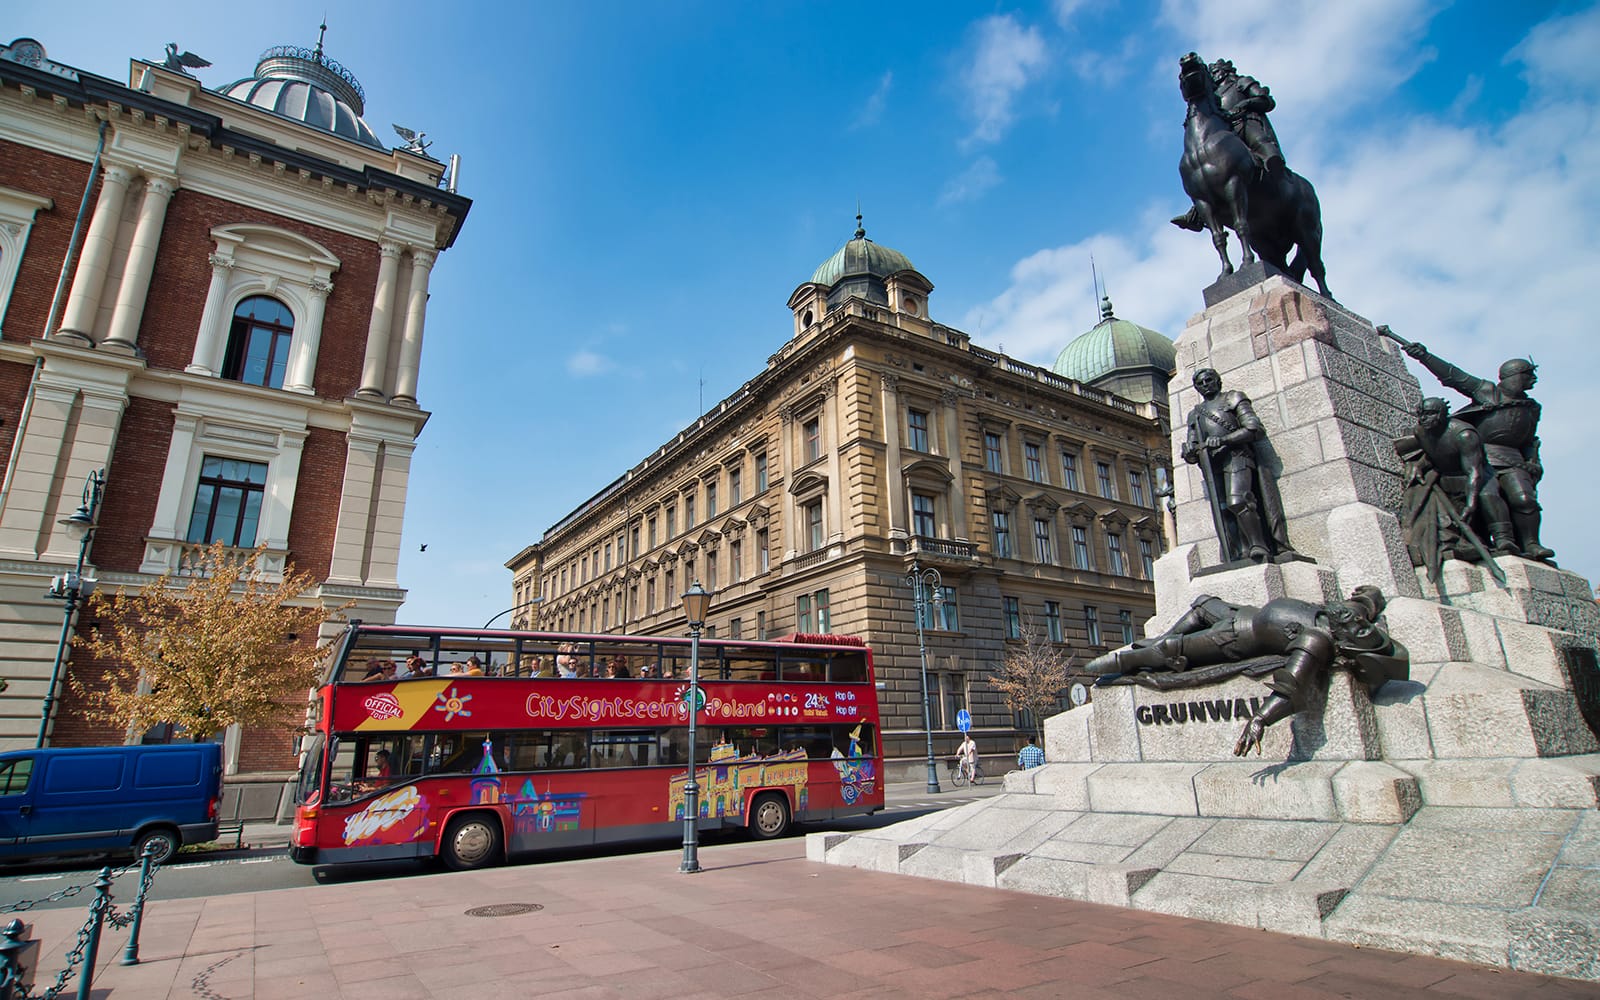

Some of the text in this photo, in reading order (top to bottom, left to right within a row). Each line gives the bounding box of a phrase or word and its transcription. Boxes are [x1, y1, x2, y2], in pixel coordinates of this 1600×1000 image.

[834, 690, 856, 701] Hop On
[364, 698, 401, 718] OFFICIAL
[710, 697, 766, 718] Poland
[835, 705, 848, 716] Hop
[371, 710, 388, 720] TOUR
